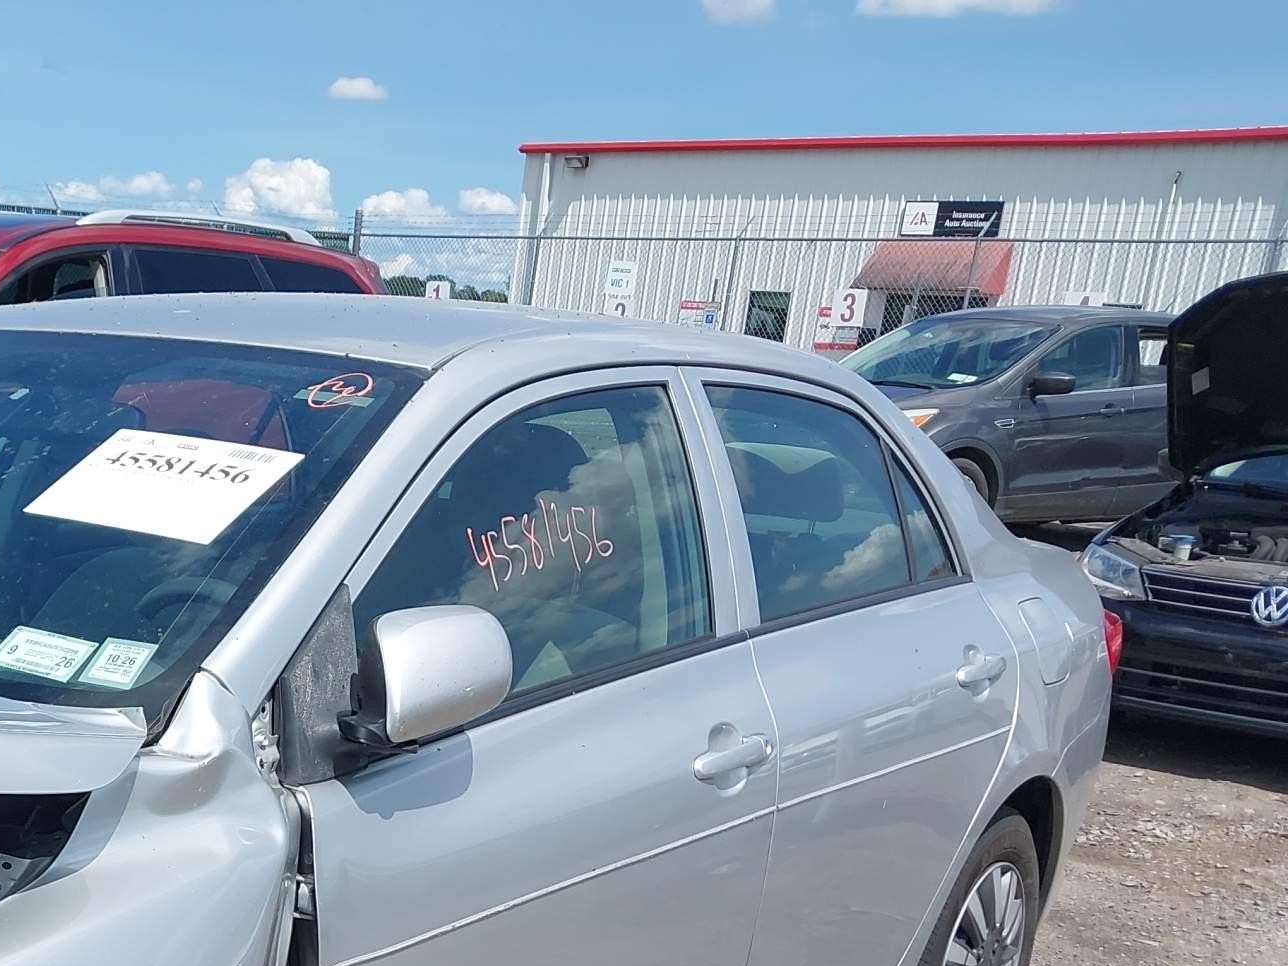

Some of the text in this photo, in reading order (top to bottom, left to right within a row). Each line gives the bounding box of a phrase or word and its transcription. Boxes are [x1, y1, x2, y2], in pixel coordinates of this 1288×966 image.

[952, 210, 985, 219] Insurance
[944, 218, 960, 228] Auto
[840, 292, 857, 323] 3
[105, 450, 257, 485] 45581456
[466, 498, 614, 592] 45581456
[7, 644, 19, 655] 9
[54, 656, 76, 669] 26
